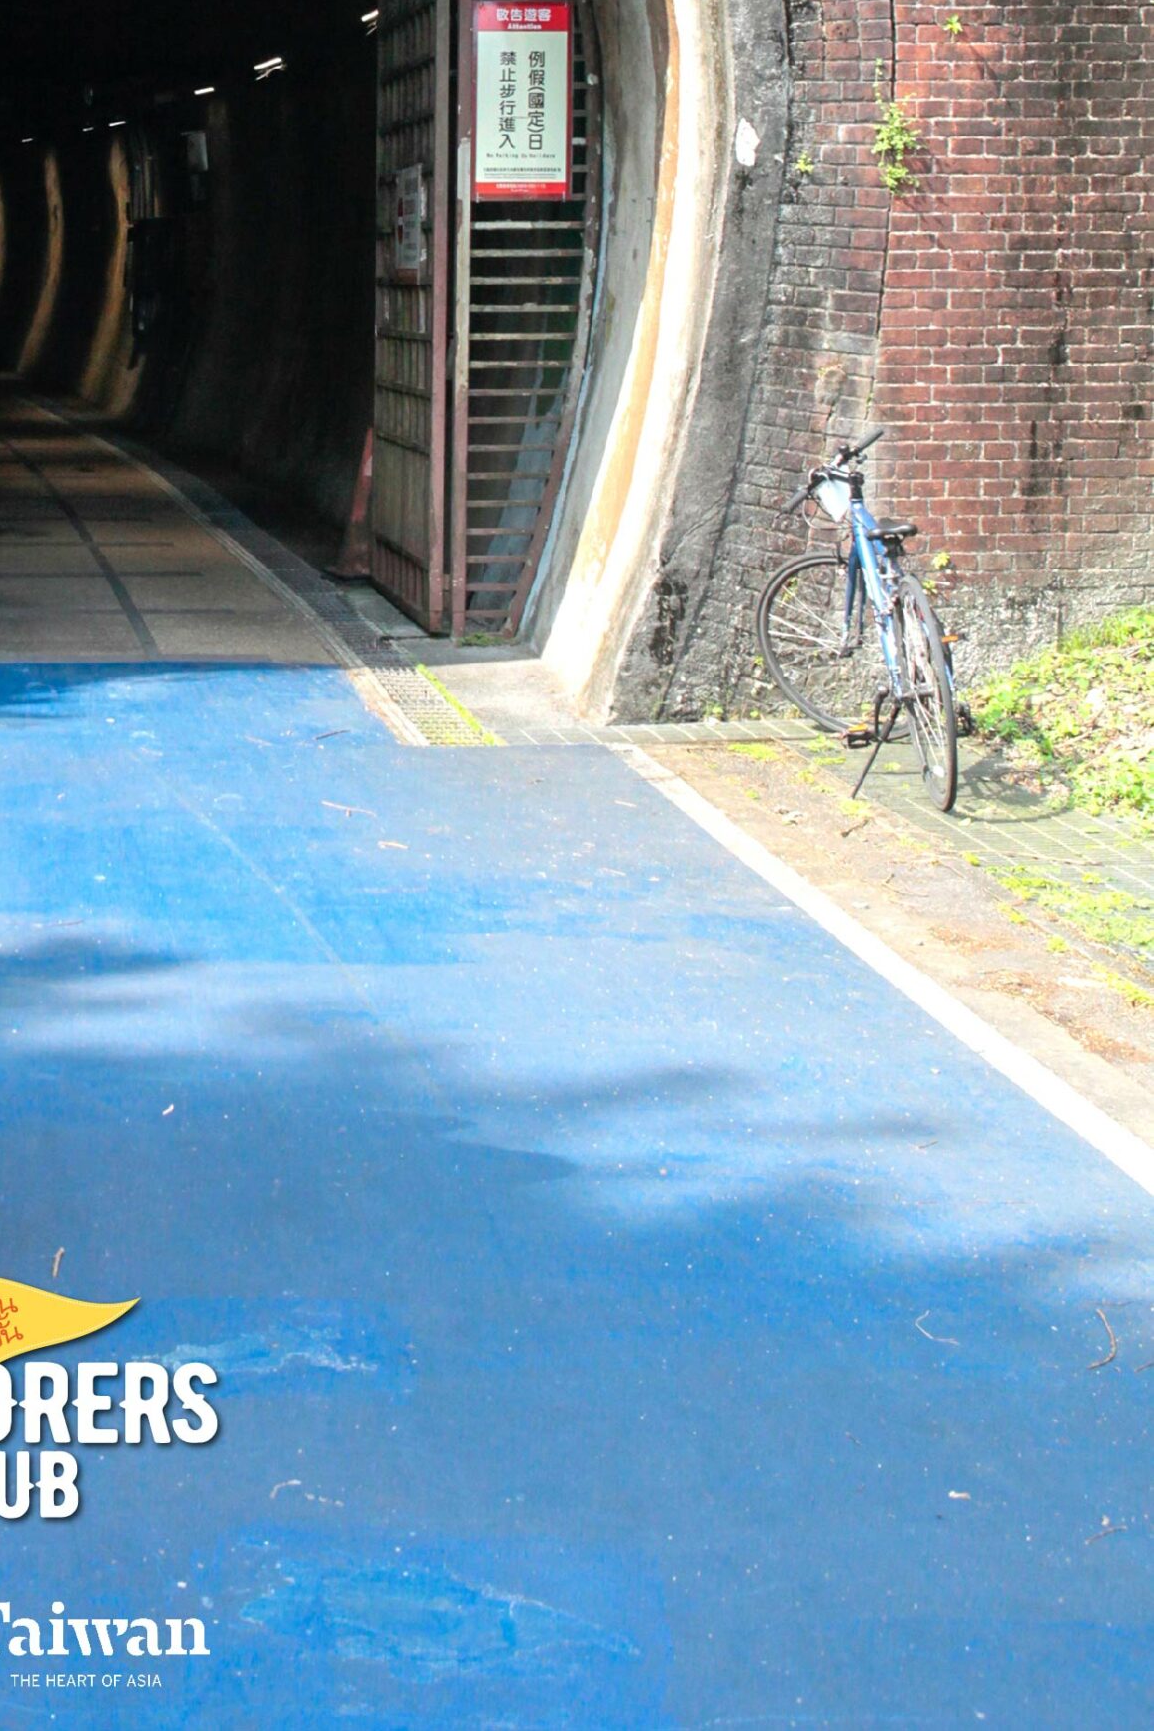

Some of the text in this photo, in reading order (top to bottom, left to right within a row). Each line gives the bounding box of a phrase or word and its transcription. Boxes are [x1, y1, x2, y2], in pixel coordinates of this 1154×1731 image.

[498, 51, 517, 150] 禁止步行進入
[527, 51, 545, 150] 例假(國定)日
